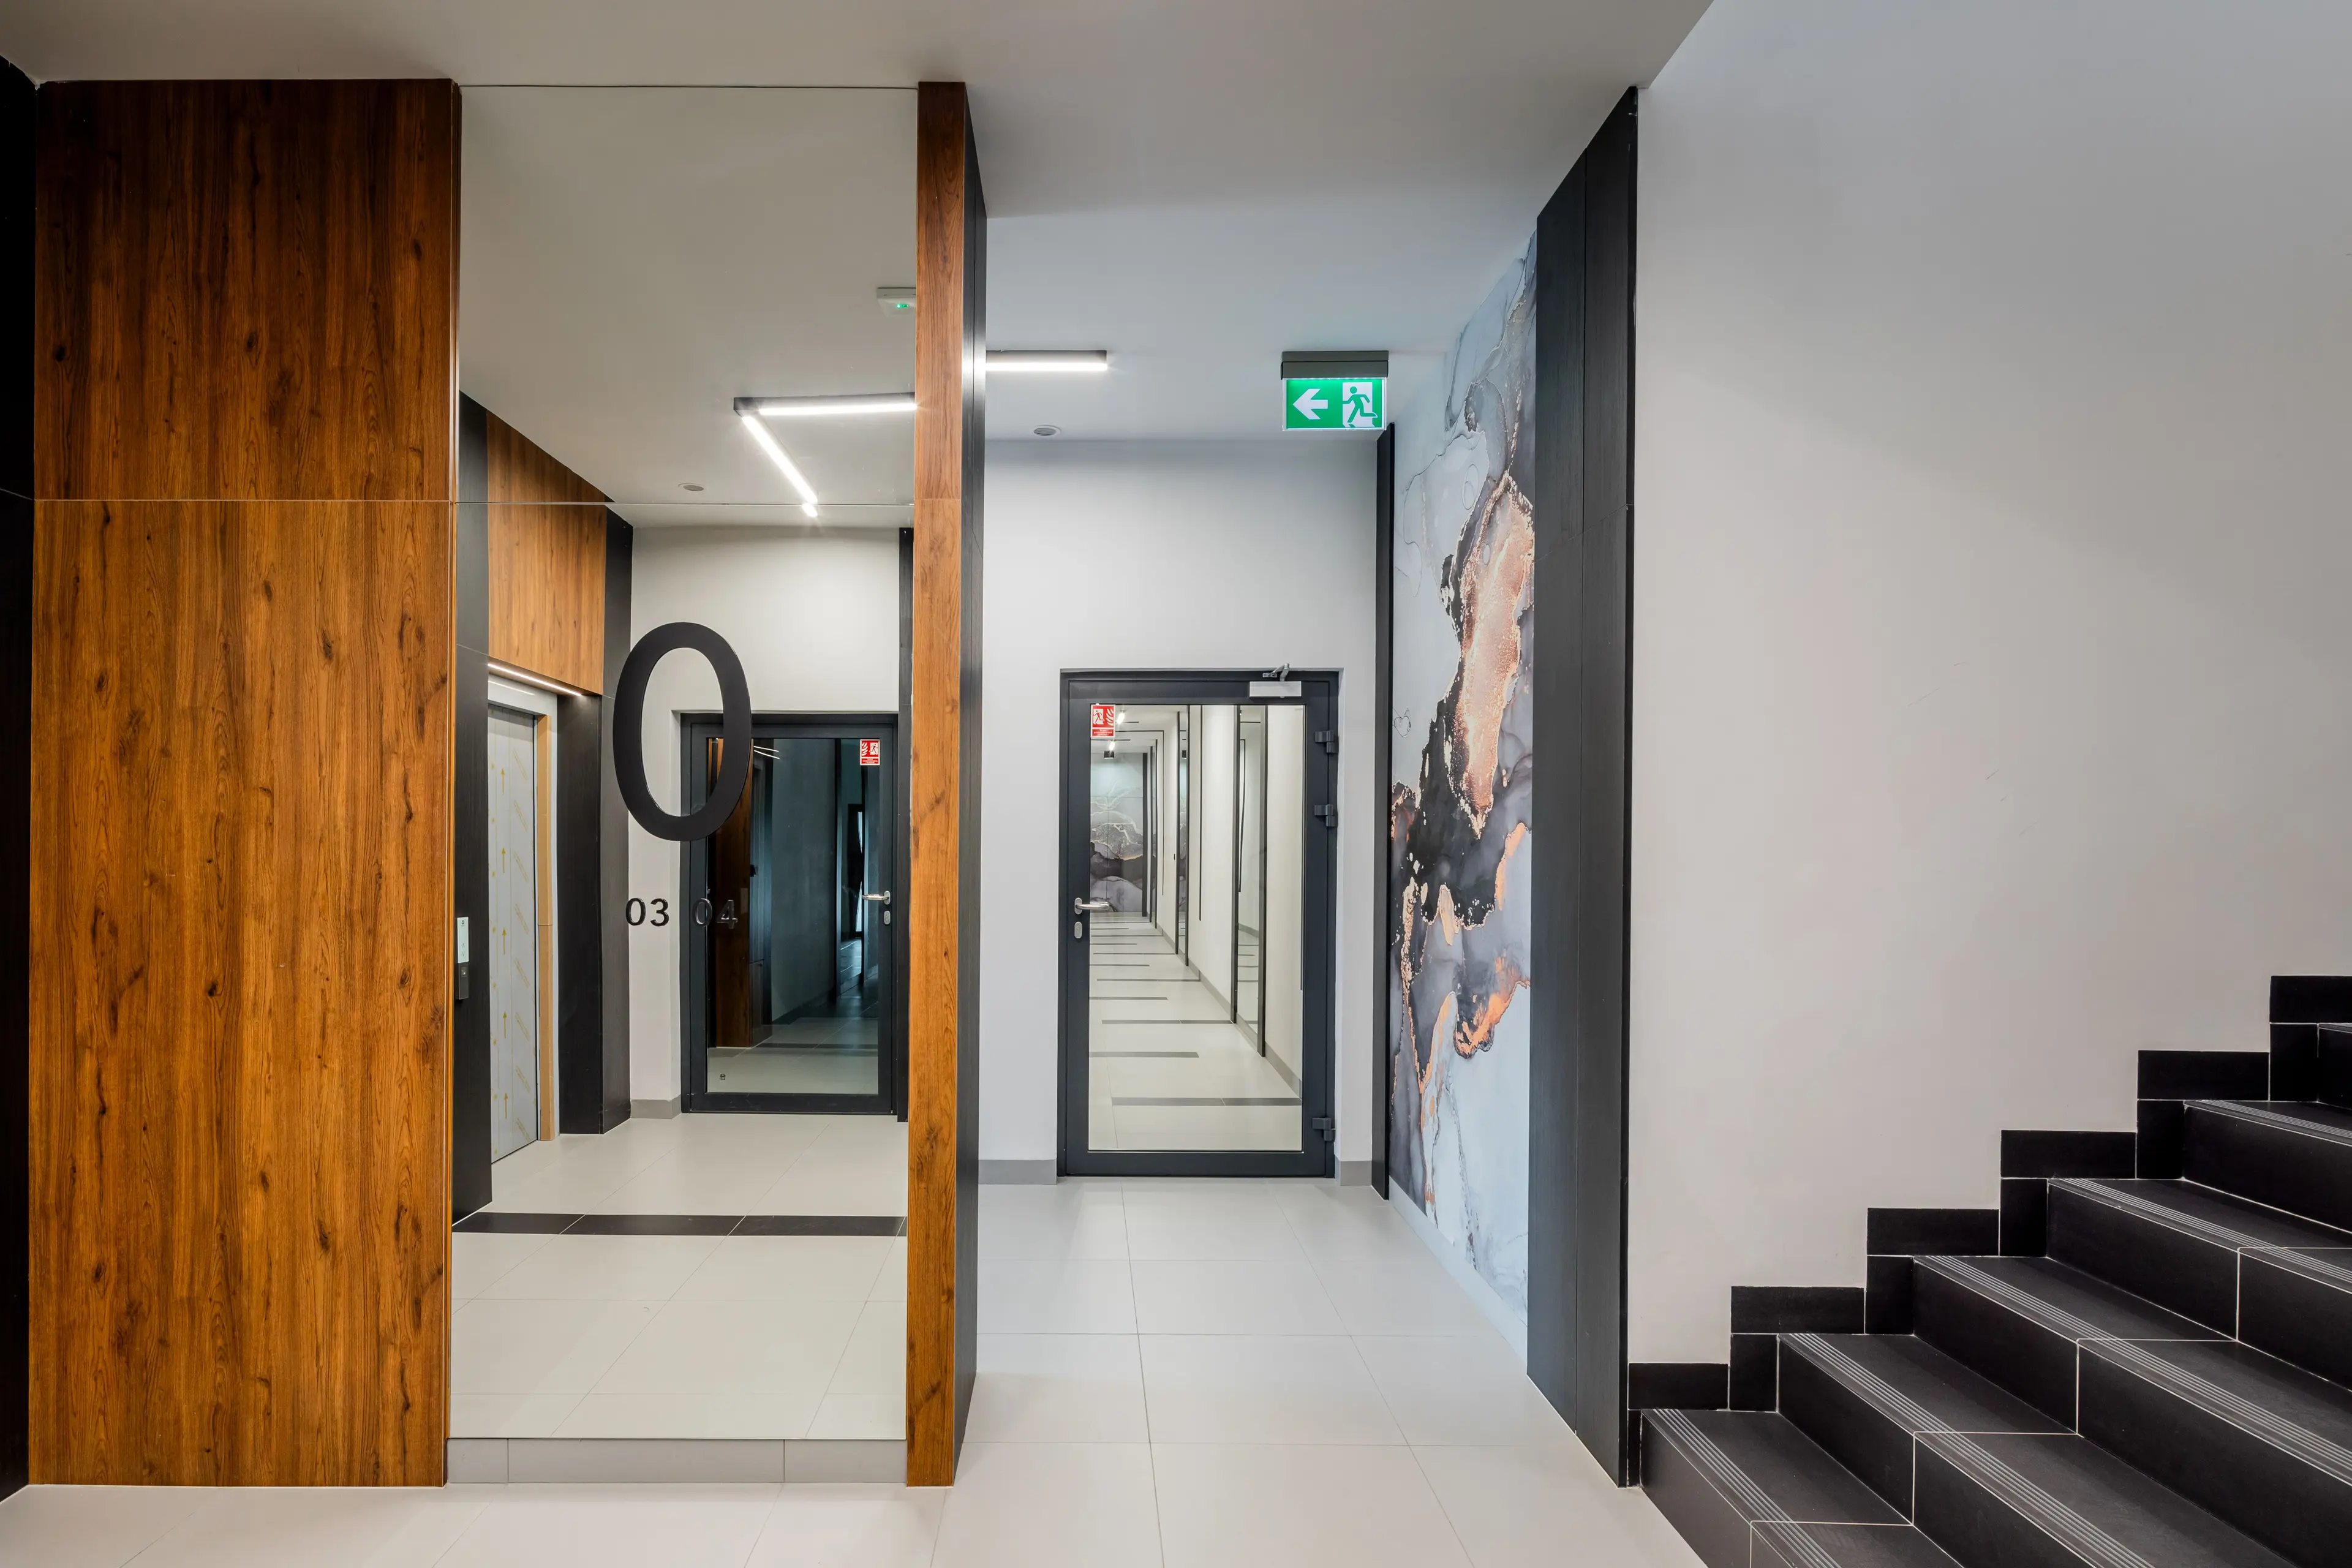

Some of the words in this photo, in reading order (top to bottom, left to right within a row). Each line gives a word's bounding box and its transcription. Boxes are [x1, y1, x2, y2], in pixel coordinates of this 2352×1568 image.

[612, 622, 752, 842] 0
[625, 898, 669, 927] 03
[692, 898, 738, 929] 04
